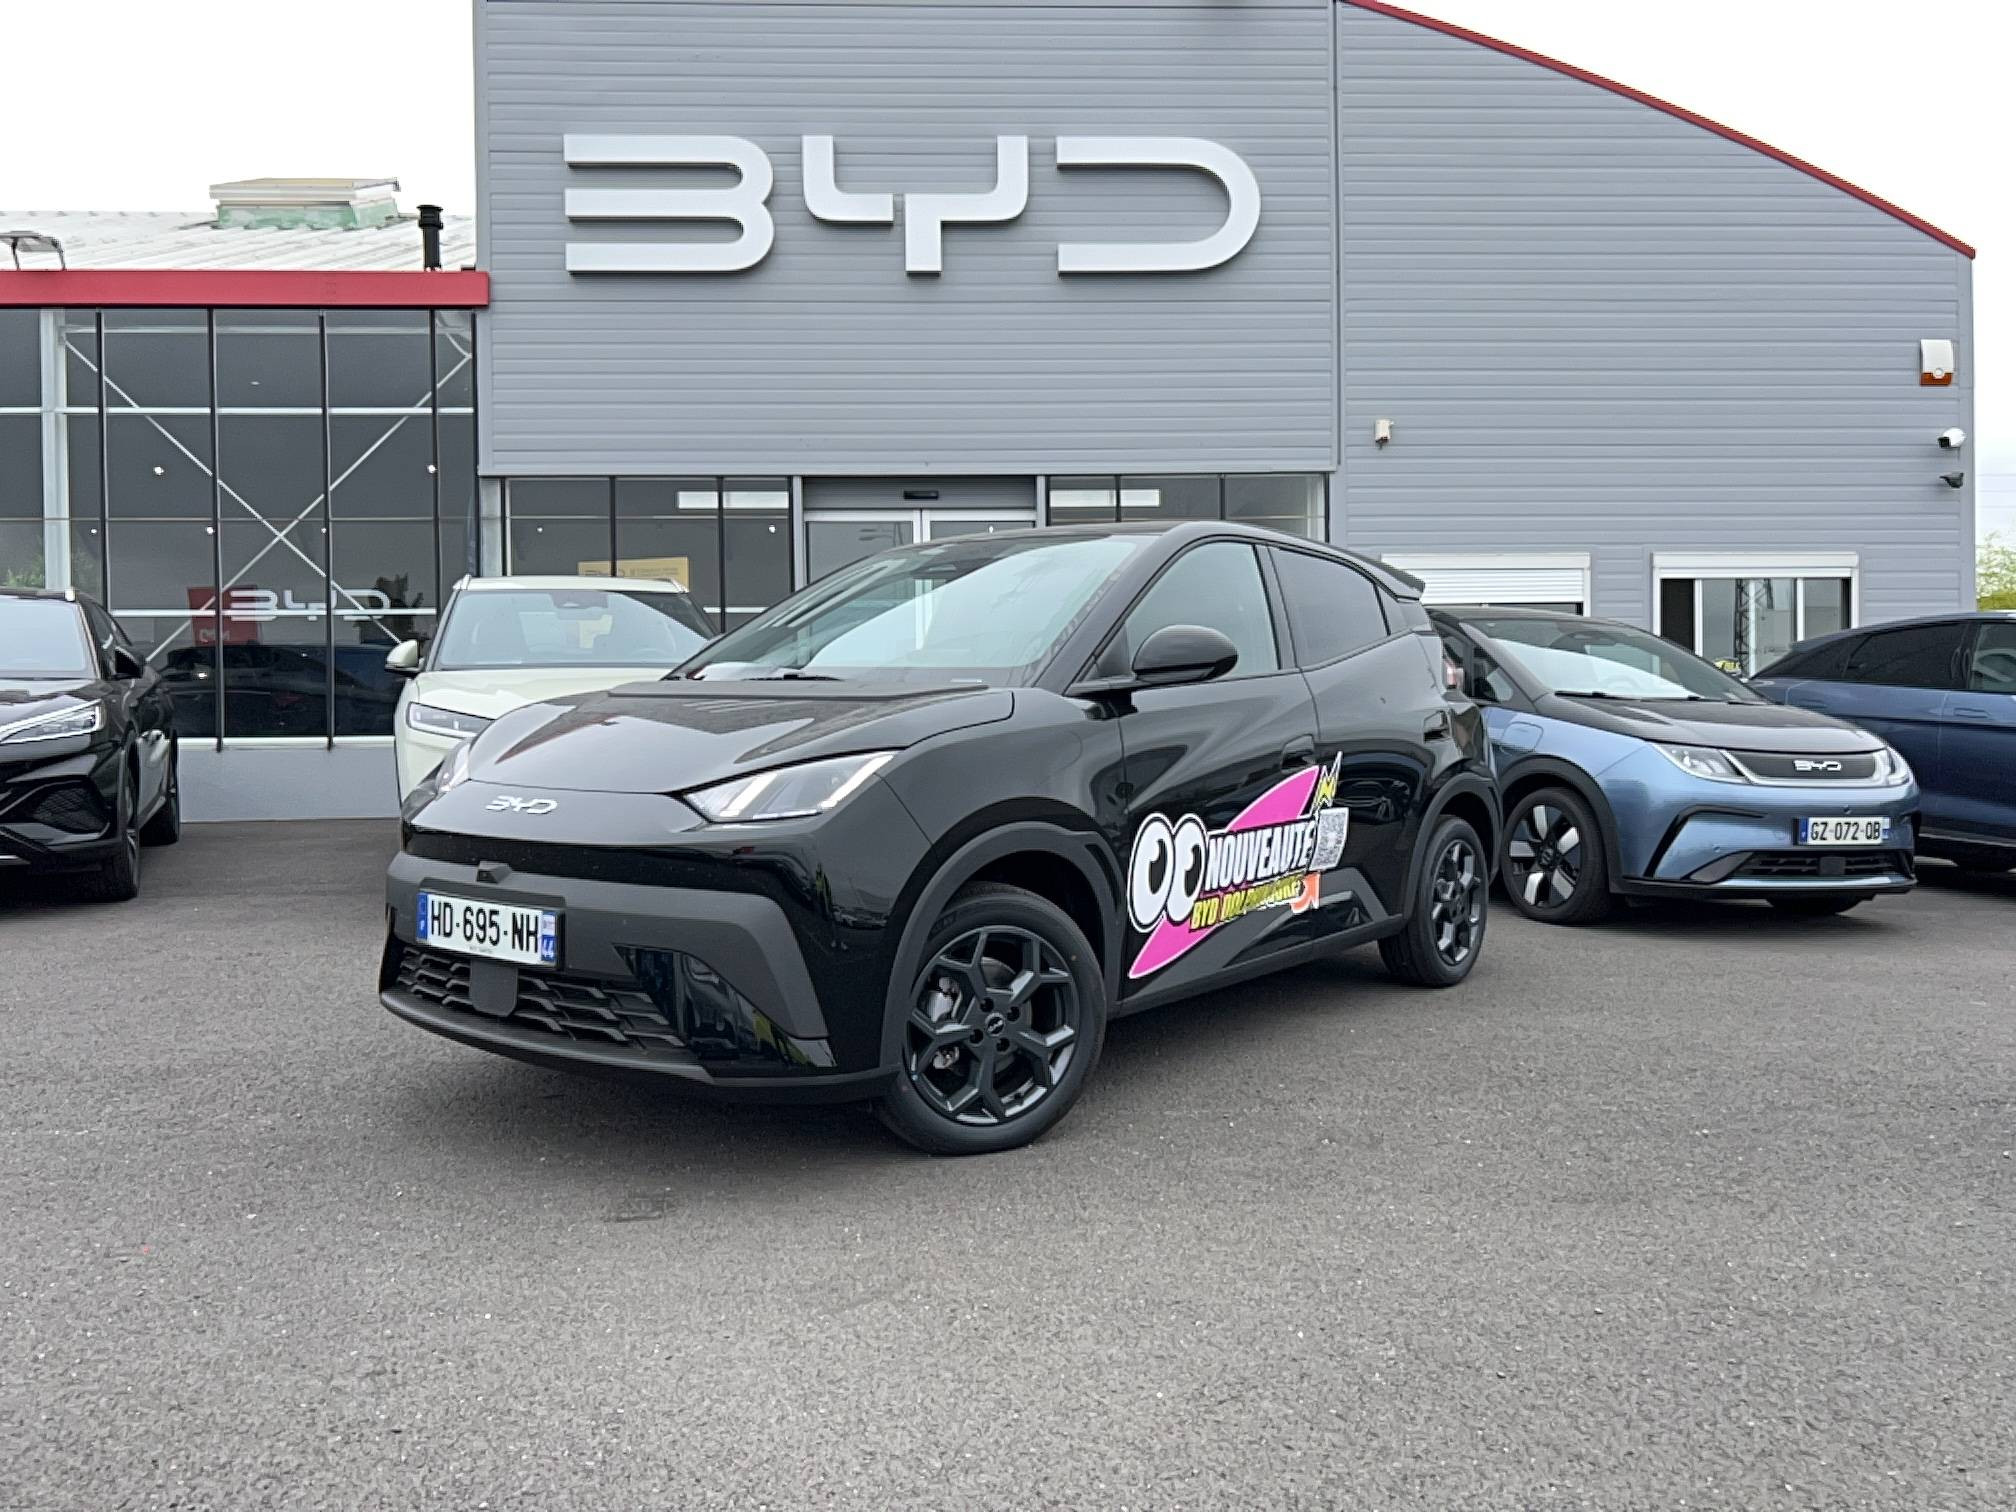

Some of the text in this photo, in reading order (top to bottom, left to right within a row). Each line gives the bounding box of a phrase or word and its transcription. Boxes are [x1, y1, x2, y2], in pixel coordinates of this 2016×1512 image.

[564, 134, 1261, 275] BYD
[230, 590, 390, 621] BYD
[1795, 760, 1842, 771] BYD
[485, 795, 558, 814] BYD
[431, 900, 539, 953] HD-695-NH
